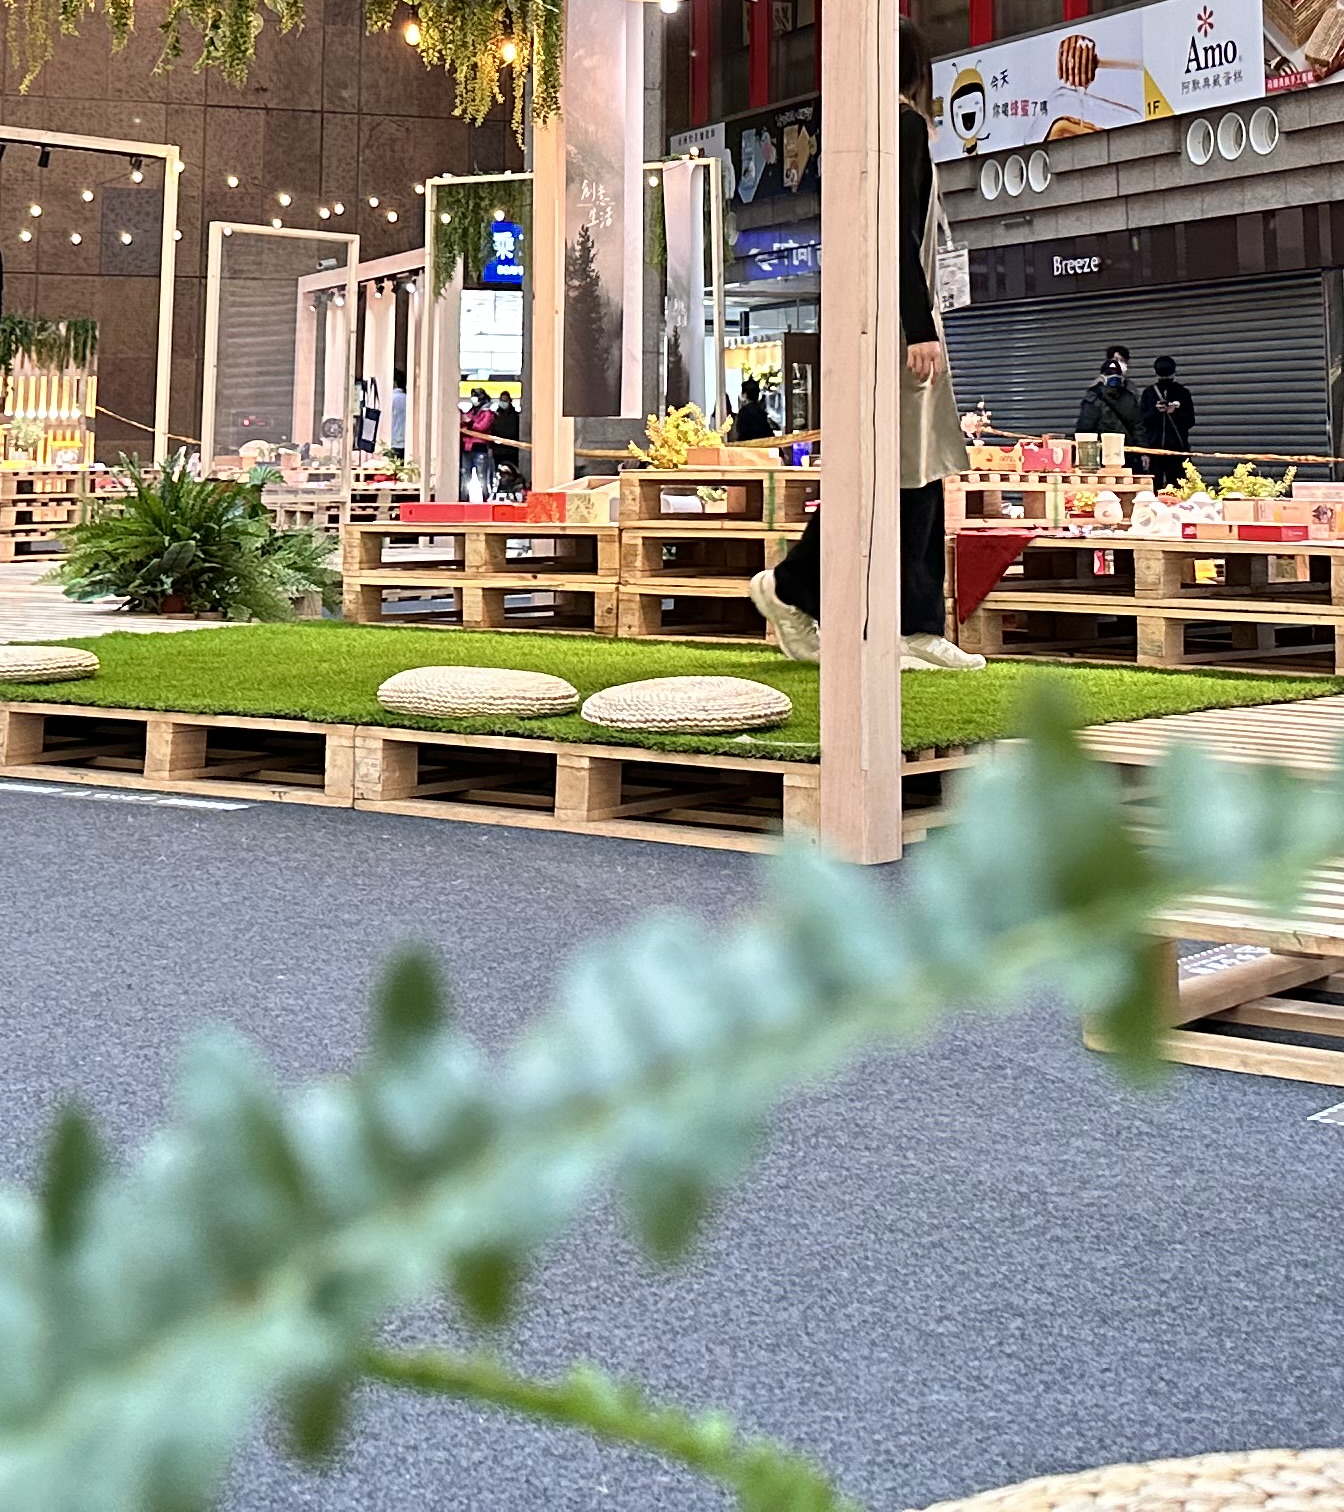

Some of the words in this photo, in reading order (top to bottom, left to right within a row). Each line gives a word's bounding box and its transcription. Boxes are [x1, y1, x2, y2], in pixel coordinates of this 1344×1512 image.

[1184, 35, 1238, 75] Amo
[990, 68, 1010, 91] 今天
[1147, 99, 1162, 116] 1F
[1052, 256, 1101, 276] Breeze
